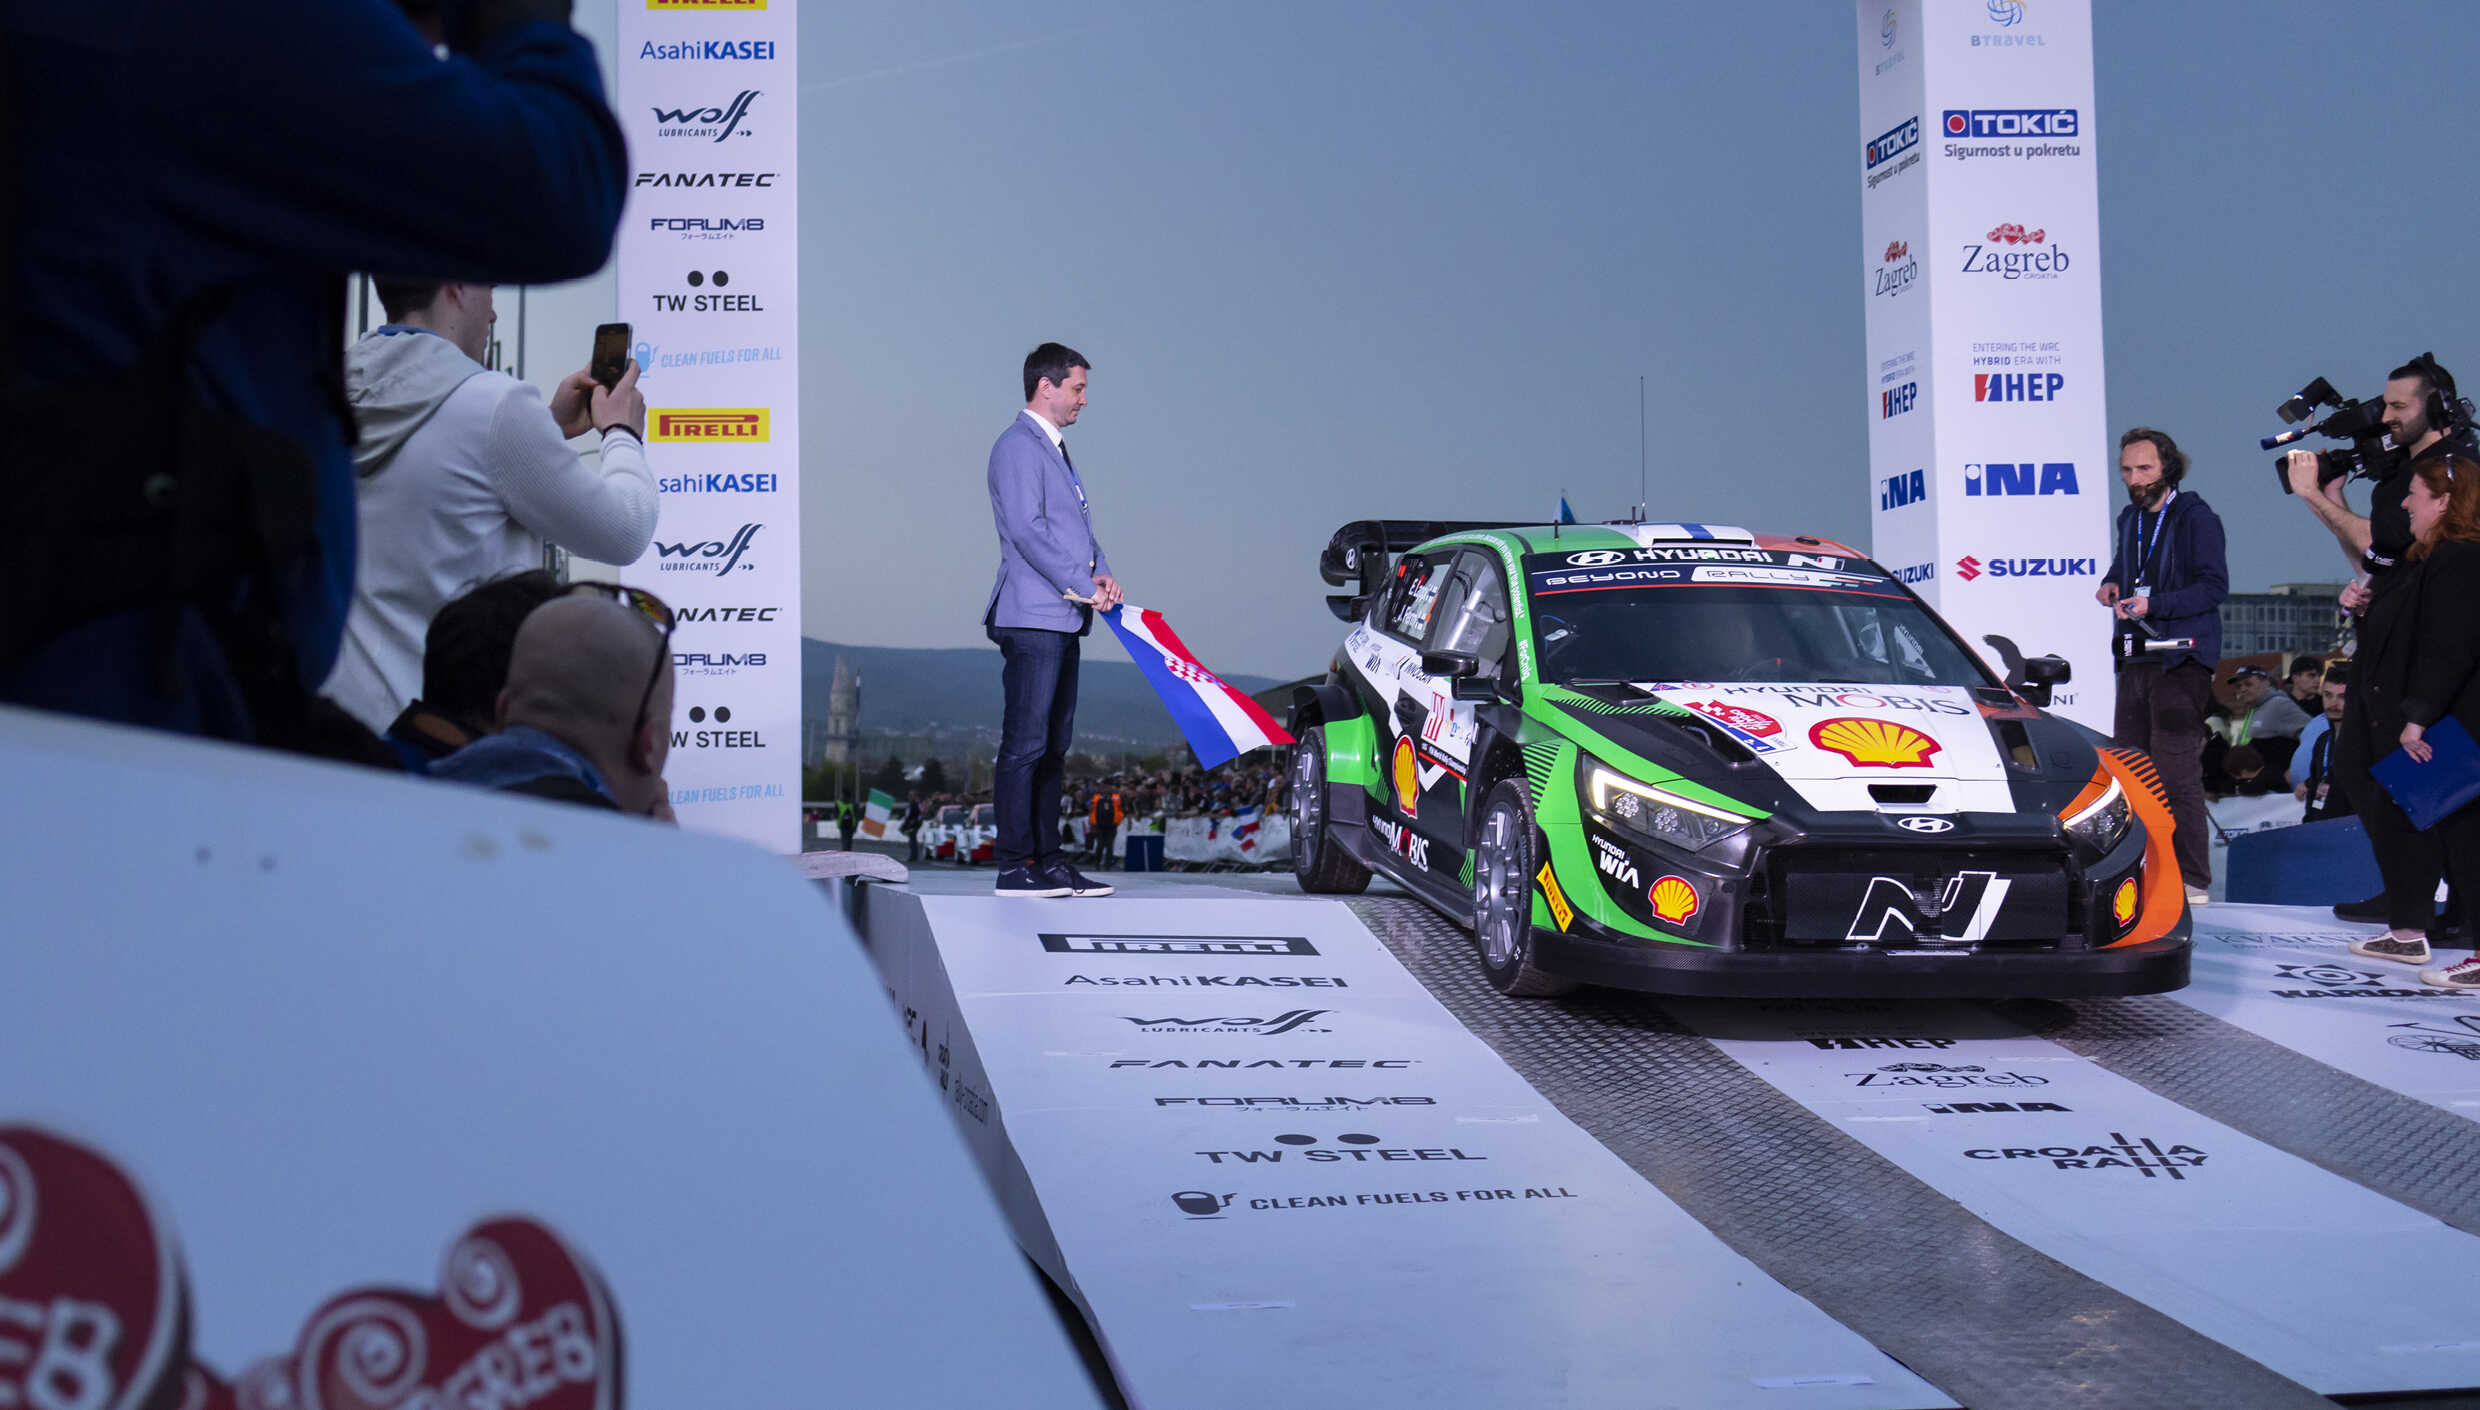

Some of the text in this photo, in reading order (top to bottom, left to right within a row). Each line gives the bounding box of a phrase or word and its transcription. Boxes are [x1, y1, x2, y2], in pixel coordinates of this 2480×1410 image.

[1975, 110, 2075, 134] TOKIĆ
[659, 128, 718, 138] LUBRICANTS
[1878, 119, 1918, 160] TOKIĆ
[1945, 143, 2080, 160] Sigurnost u pokretu
[635, 173, 775, 187] FANATEC
[651, 219, 764, 231] FORUM8
[1962, 244, 2069, 280] Zagreb
[1875, 254, 1918, 297] Zagreb
[653, 296, 763, 312] TW STEEL
[1973, 342, 2060, 352] ENTERING THE WRC
[661, 346, 783, 368] CLEAN FUELS FOR ALL
[1973, 355, 2062, 366] HYBRID ERA WITH
[659, 414, 760, 437] PIRELLI
[659, 473, 777, 493] sahiKASEI
[1633, 549, 1774, 563] HYUNDAI
[660, 562, 720, 571] LUBRICANTS
[1988, 558, 2096, 576] SUZUKI
[1546, 570, 1810, 586] BEYOND RALLY
[676, 607, 778, 622] NATEC
[672, 654, 767, 666] ORUM8
[1724, 686, 1873, 695] HYUNDAI
[1783, 694, 1971, 715] MOBIS
[670, 731, 766, 748] W STEEL
[670, 783, 785, 805] LEAN FUELS FOR ALL
[1388, 821, 1430, 873] MOBIS
[1592, 833, 1626, 860] HYUNDAI
[1064, 937, 1294, 953] PIRELLI
[1110, 1060, 1412, 1068] FANATEC
[1844, 1071, 2050, 1089] Zagreb
[1155, 1096, 1437, 1106] FORUM8
[1963, 1133, 2209, 1160] CROATIA
[1195, 1149, 1488, 1164] TW STEEL
[2053, 1156, 2209, 1180] RALLY
[1251, 1186, 1579, 1211] CLEAN FUELS FOR ALL
